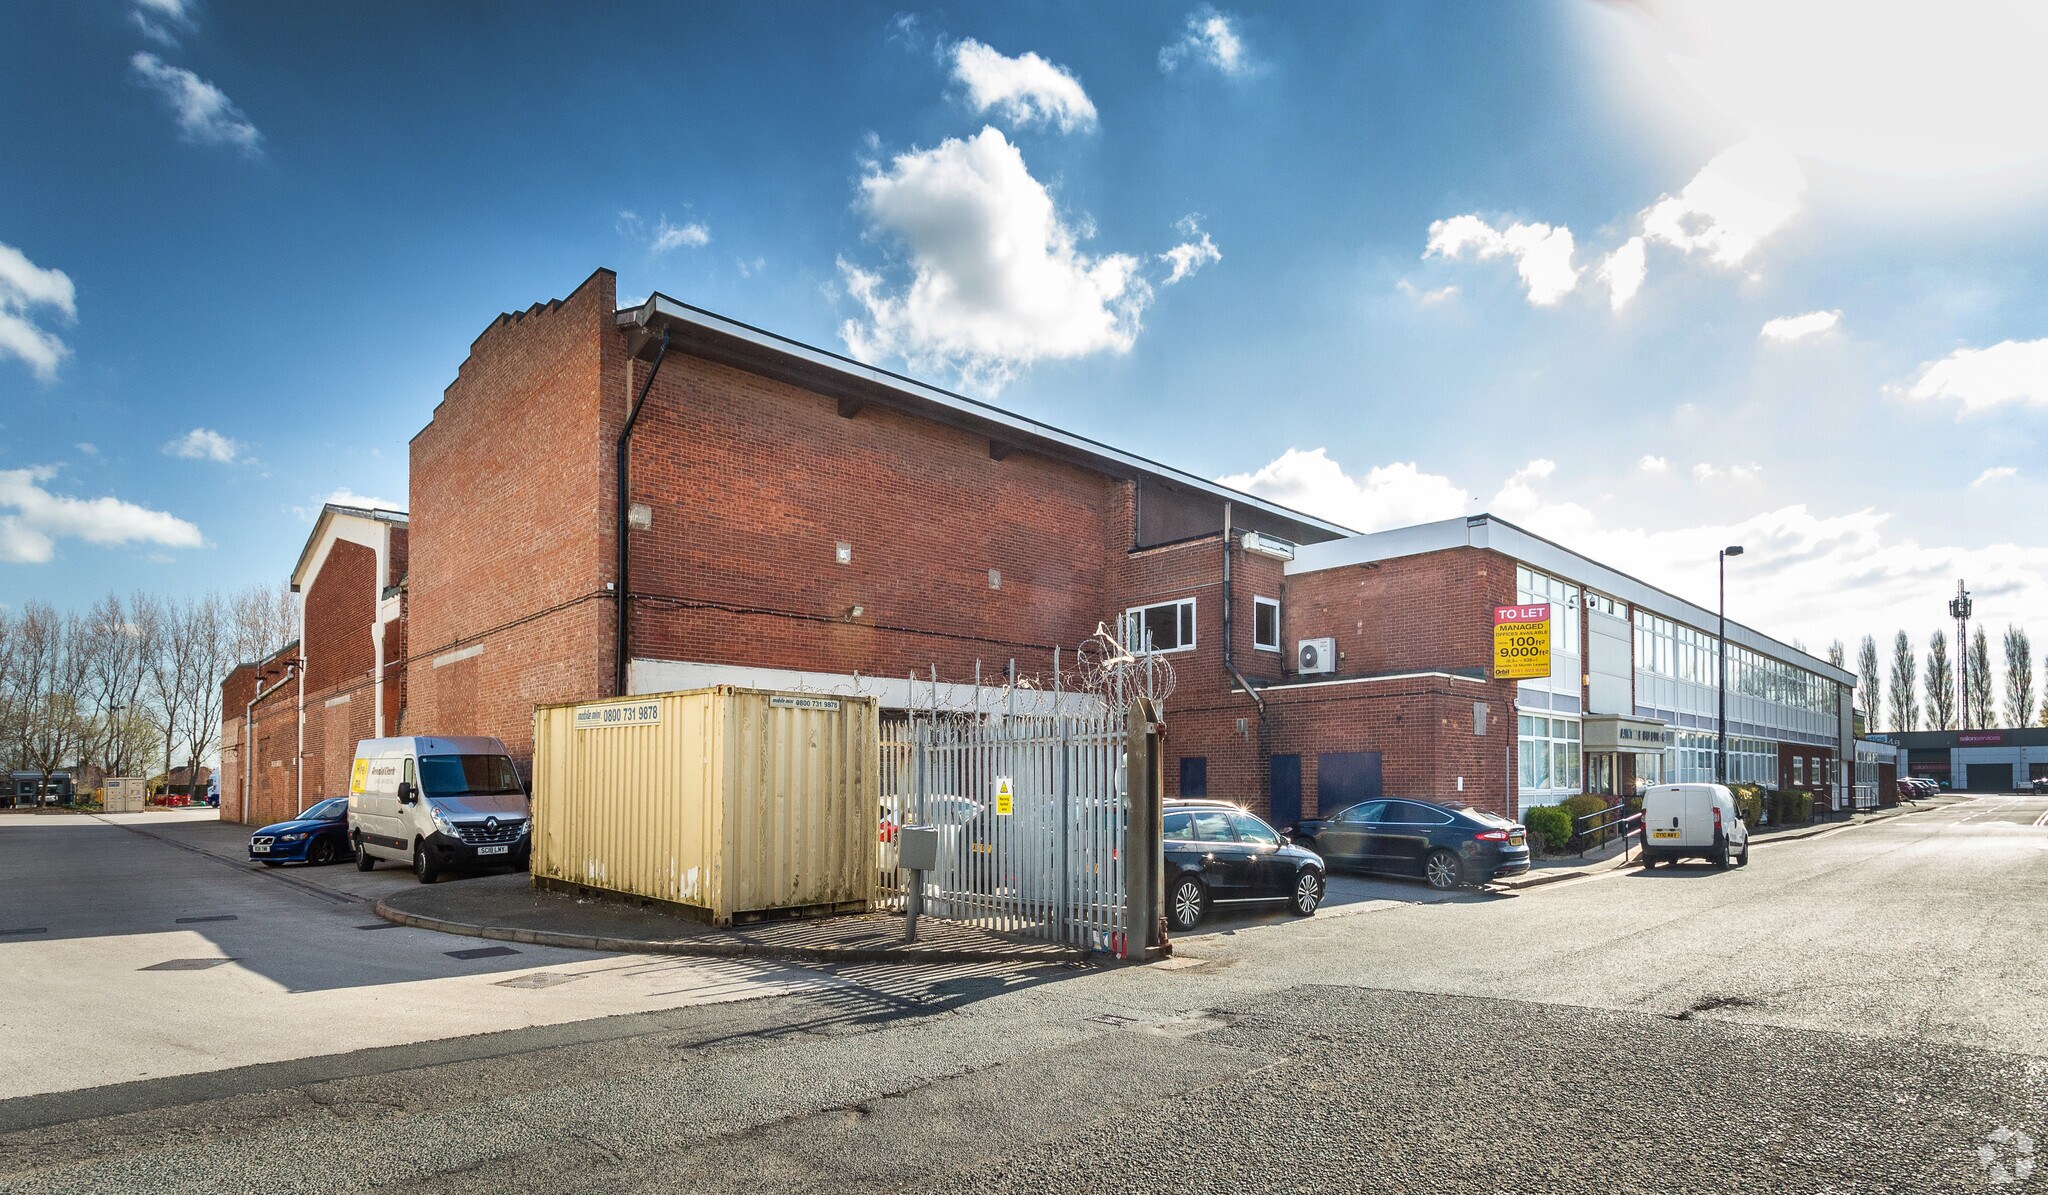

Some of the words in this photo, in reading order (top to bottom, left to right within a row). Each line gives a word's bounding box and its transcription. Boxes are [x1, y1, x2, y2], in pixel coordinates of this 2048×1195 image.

[1498, 610, 1516, 619] TO
[1521, 608, 1545, 618] LET
[1499, 623, 1544, 631] MANAGED
[795, 699, 810, 707] 0800
[603, 708, 621, 722] 0800
[623, 707, 636, 721] 731
[638, 705, 658, 720] 9878
